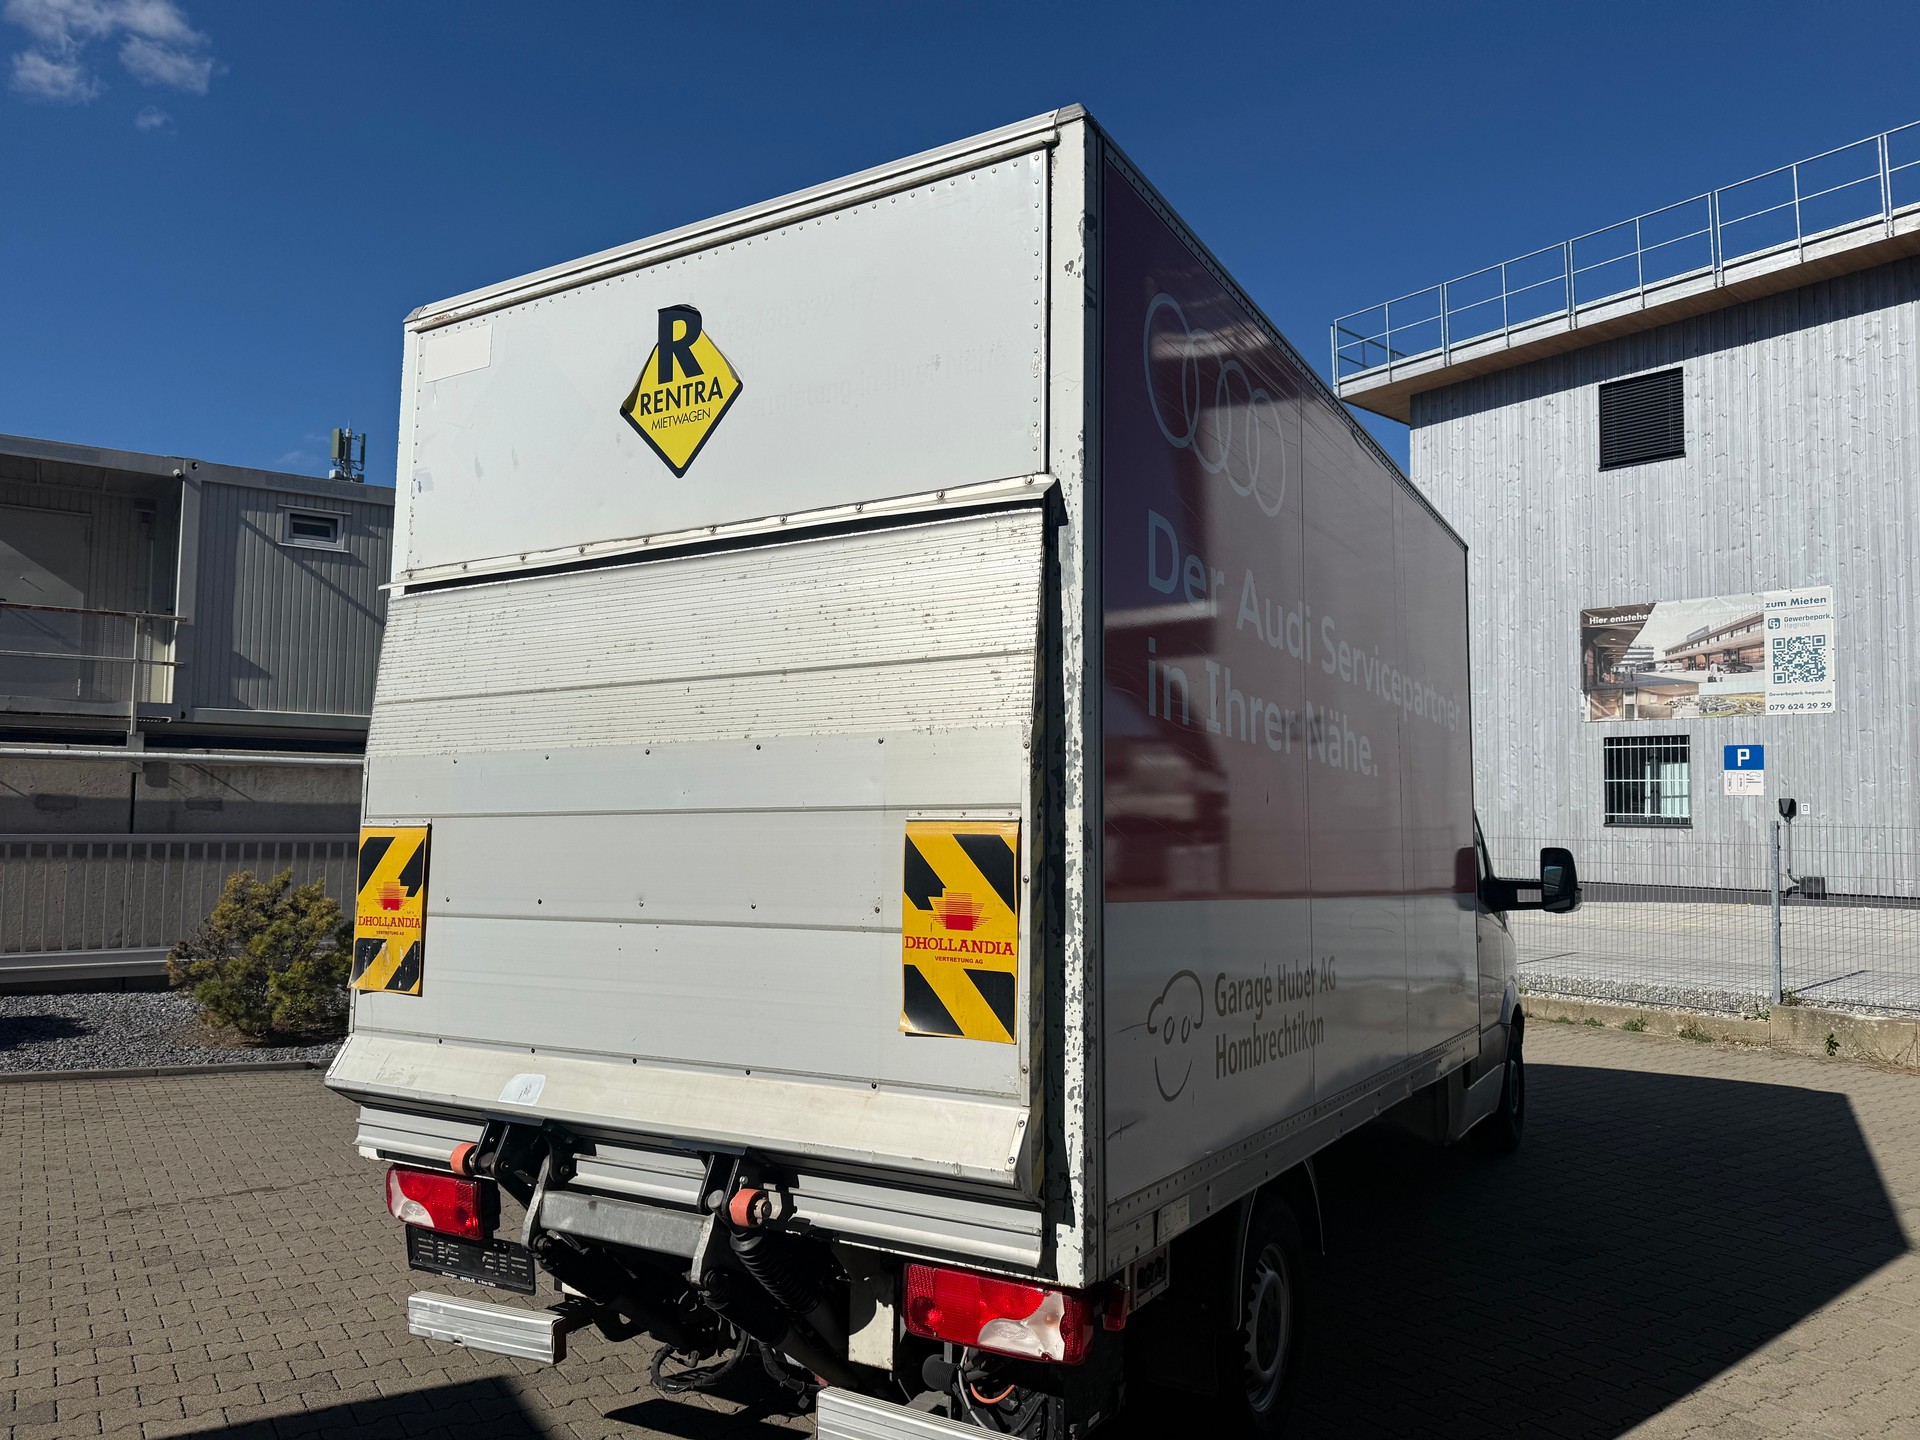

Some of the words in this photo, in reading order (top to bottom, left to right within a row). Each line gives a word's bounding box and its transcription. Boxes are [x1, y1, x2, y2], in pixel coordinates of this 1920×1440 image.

[658, 304, 704, 384] R
[640, 376, 723, 416] RENTRA
[651, 408, 711, 431] MIETWAGEN
[1790, 597, 1827, 606] Mieten
[1148, 509, 1225, 619] Der
[1236, 568, 1312, 665] Audi
[1321, 616, 1461, 733] Servicepartner
[1589, 616, 1608, 625] Hier
[1784, 613, 1830, 622] Gewerbepark
[1148, 636, 1190, 725] in
[1205, 659, 1297, 754] Ihrer
[1306, 701, 1378, 777] Nähe.
[1807, 702, 1818, 710] 29
[1737, 748, 1750, 767] P
[358, 916, 420, 928] DHOLLANDIA
[904, 936, 1015, 956] DHOLLANDIA
[934, 955, 974, 964] VERTRETUNG
[1215, 972, 1272, 1020] Garage
[1278, 958, 1317, 1004] Huber
[1319, 955, 1336, 993] AG
[1215, 1010, 1324, 1080] Hombrechtikon
